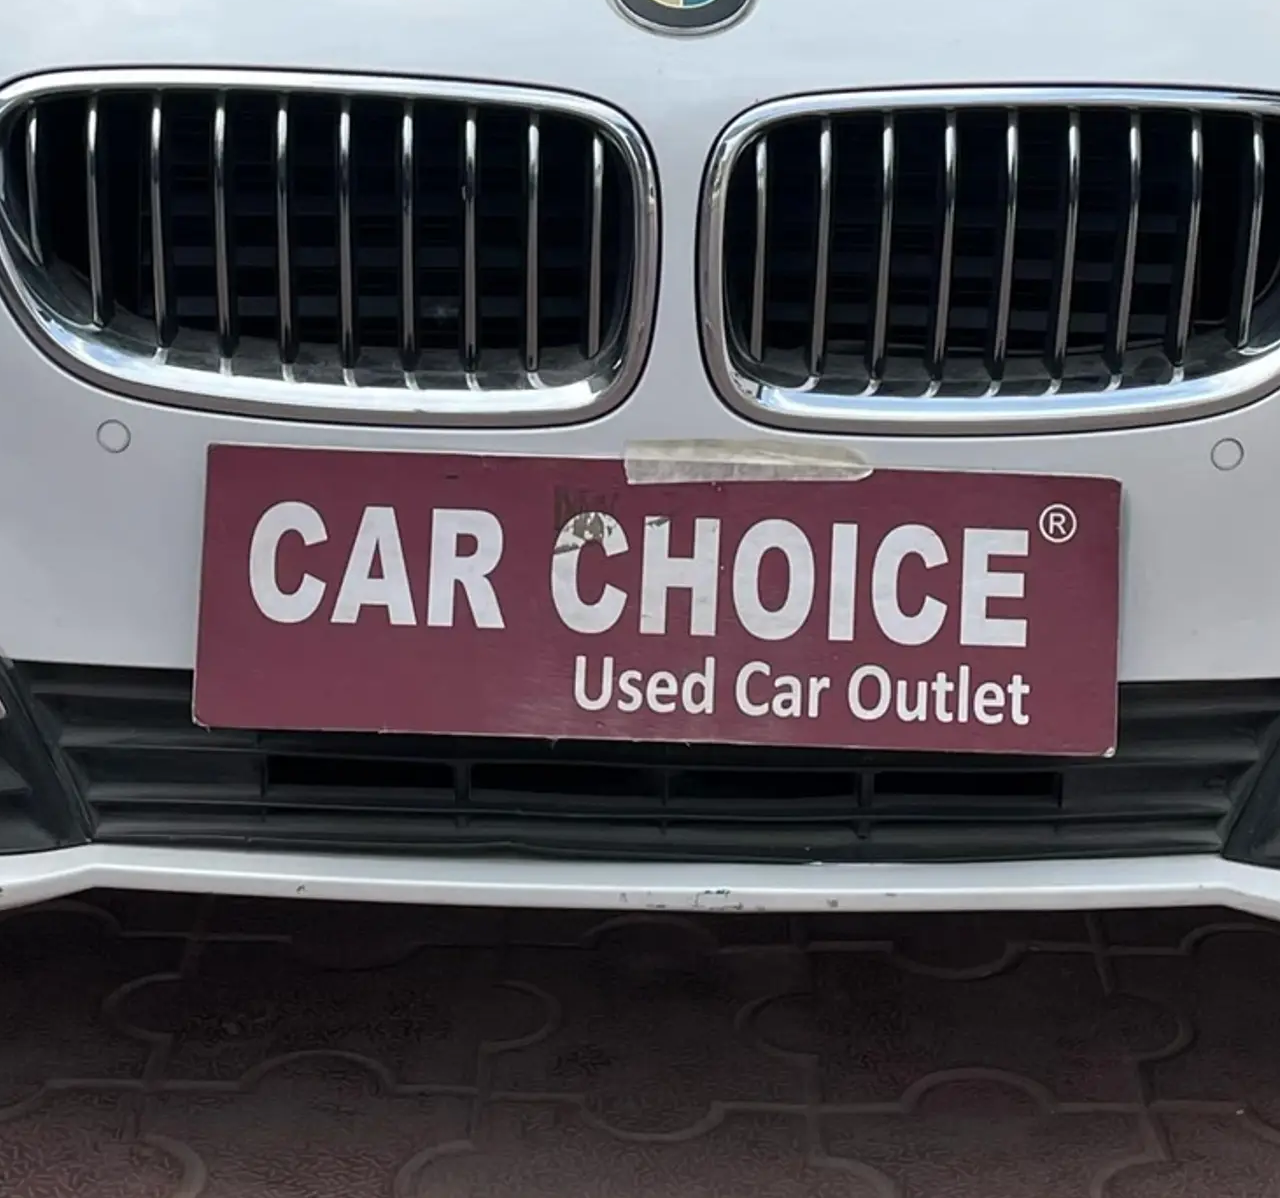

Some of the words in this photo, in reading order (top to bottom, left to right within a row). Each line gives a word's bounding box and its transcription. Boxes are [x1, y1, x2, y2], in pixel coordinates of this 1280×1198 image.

[249, 501, 505, 629] CAR
[573, 654, 714, 715] Used
[735, 661, 830, 720] Car
[848, 664, 1030, 726] Outlet
